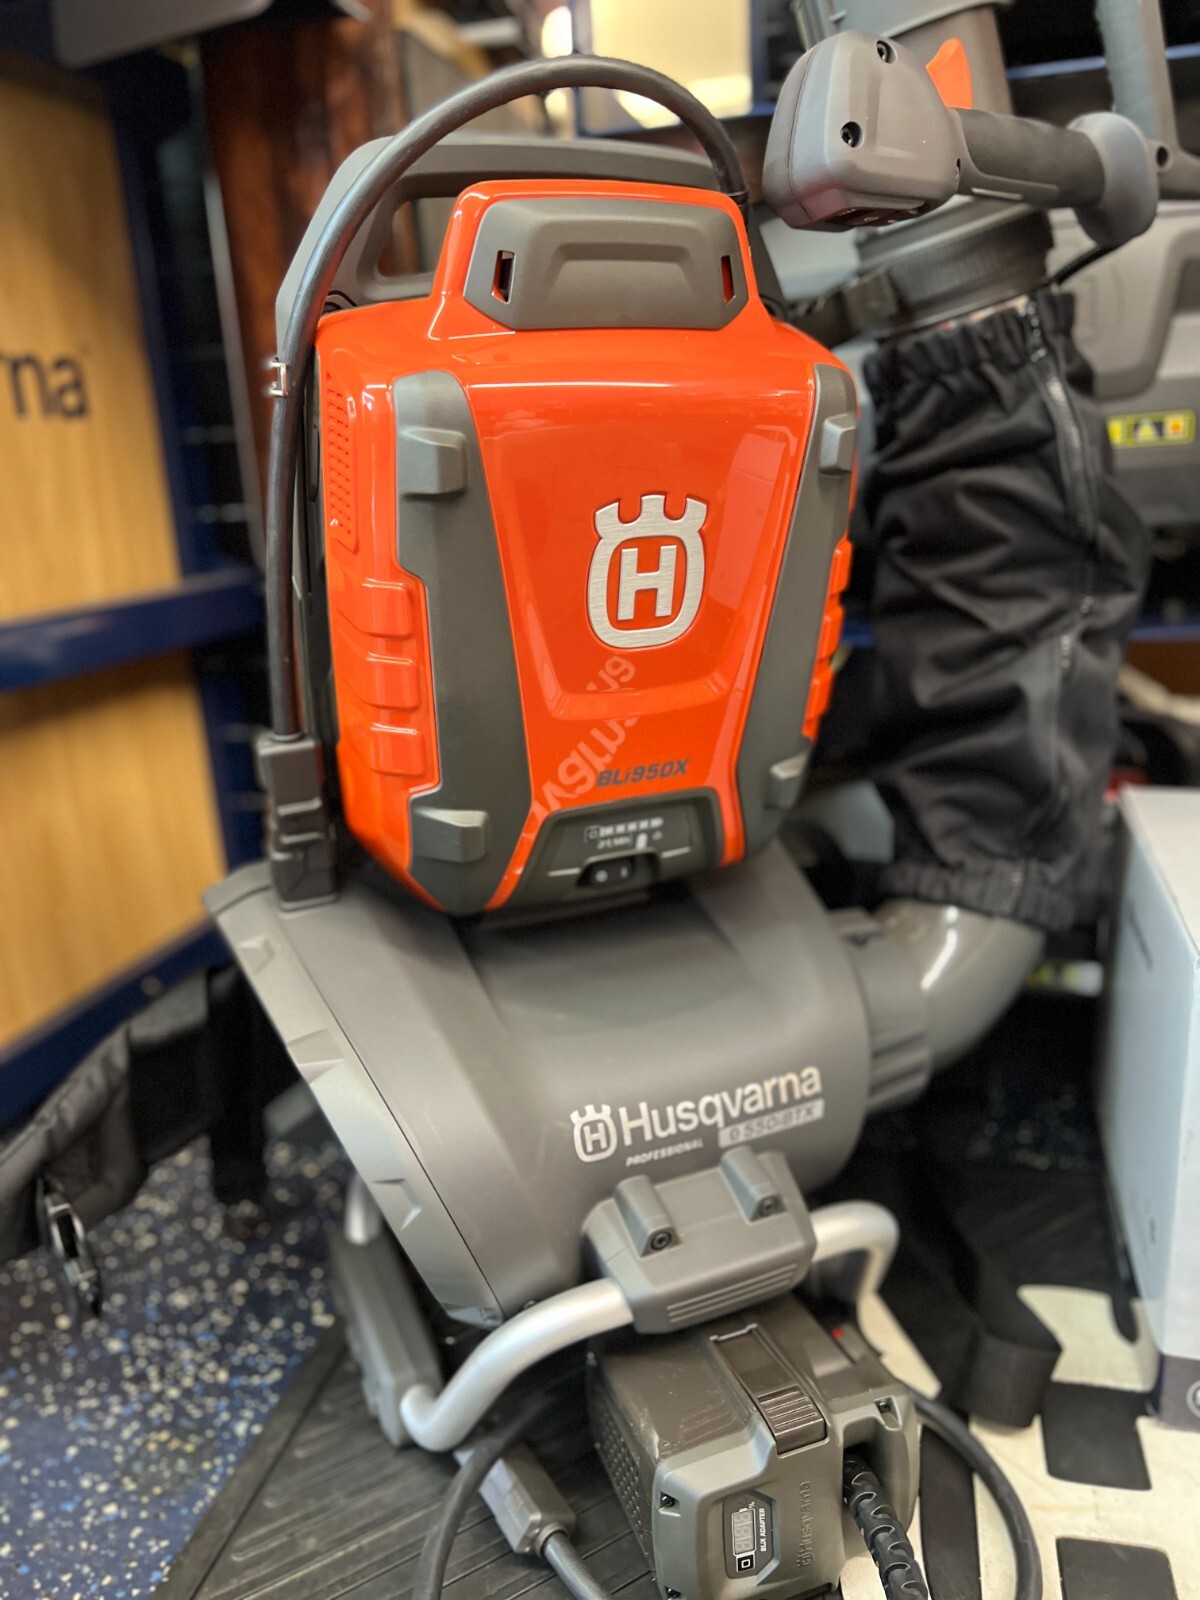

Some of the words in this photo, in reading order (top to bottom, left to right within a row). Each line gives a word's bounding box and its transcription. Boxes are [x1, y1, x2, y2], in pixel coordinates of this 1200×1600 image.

[596, 757, 691, 787] BLi950X
[618, 1065, 822, 1147] Husqvarna
[626, 1137, 704, 1168] PROFESSIONAL
[758, 1508, 767, 1537] ADAPTER
[799, 1480, 814, 1553] Husqvarna
